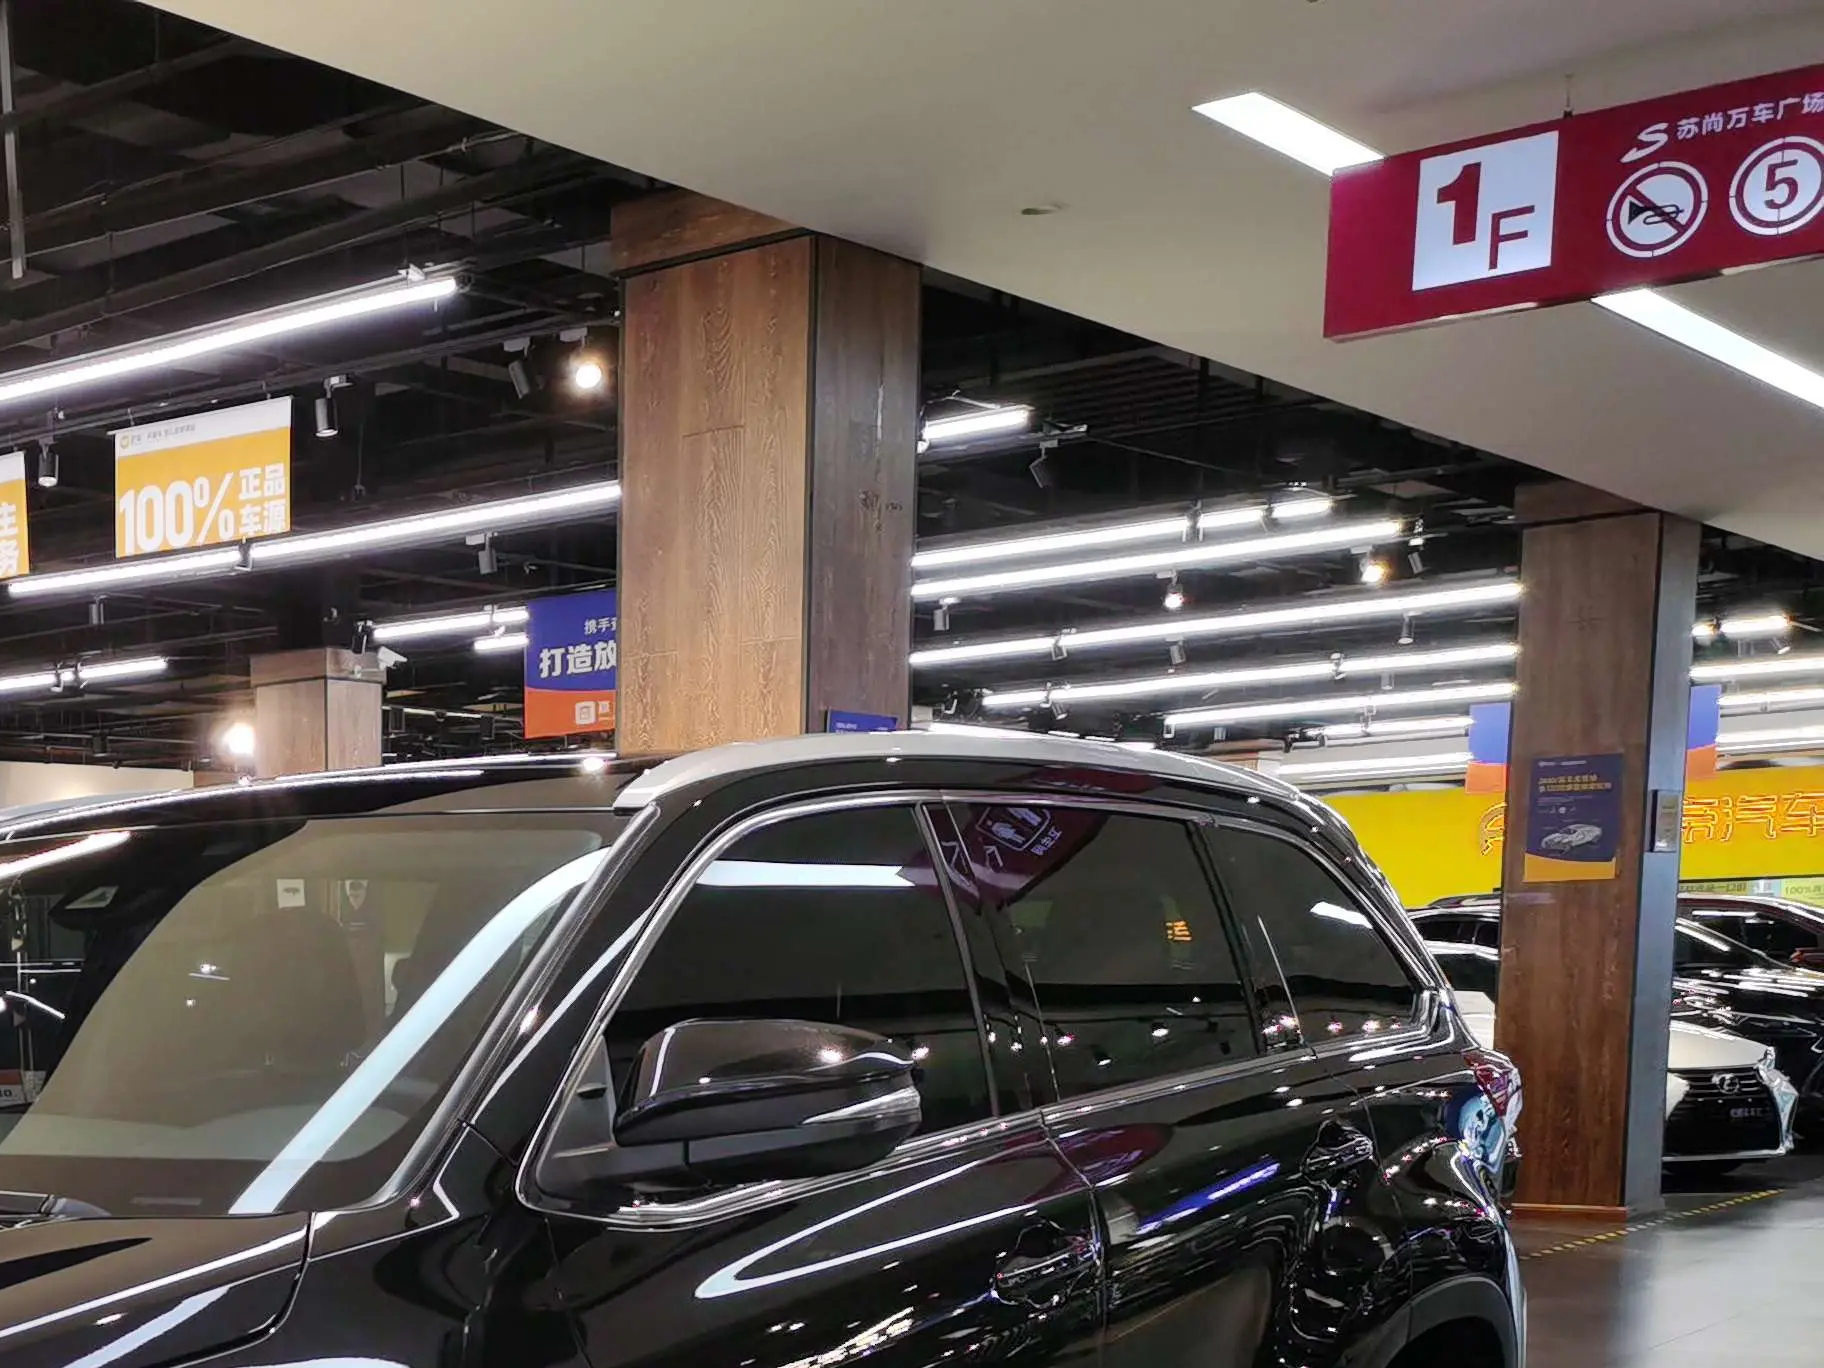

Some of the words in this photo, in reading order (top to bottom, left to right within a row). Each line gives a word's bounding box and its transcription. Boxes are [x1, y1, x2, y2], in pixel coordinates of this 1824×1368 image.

[1677, 92, 1824, 140] 苏尚万车广场
[1764, 159, 1799, 209] 5
[239, 463, 285, 501] 正品
[119, 472, 234, 556] 100%
